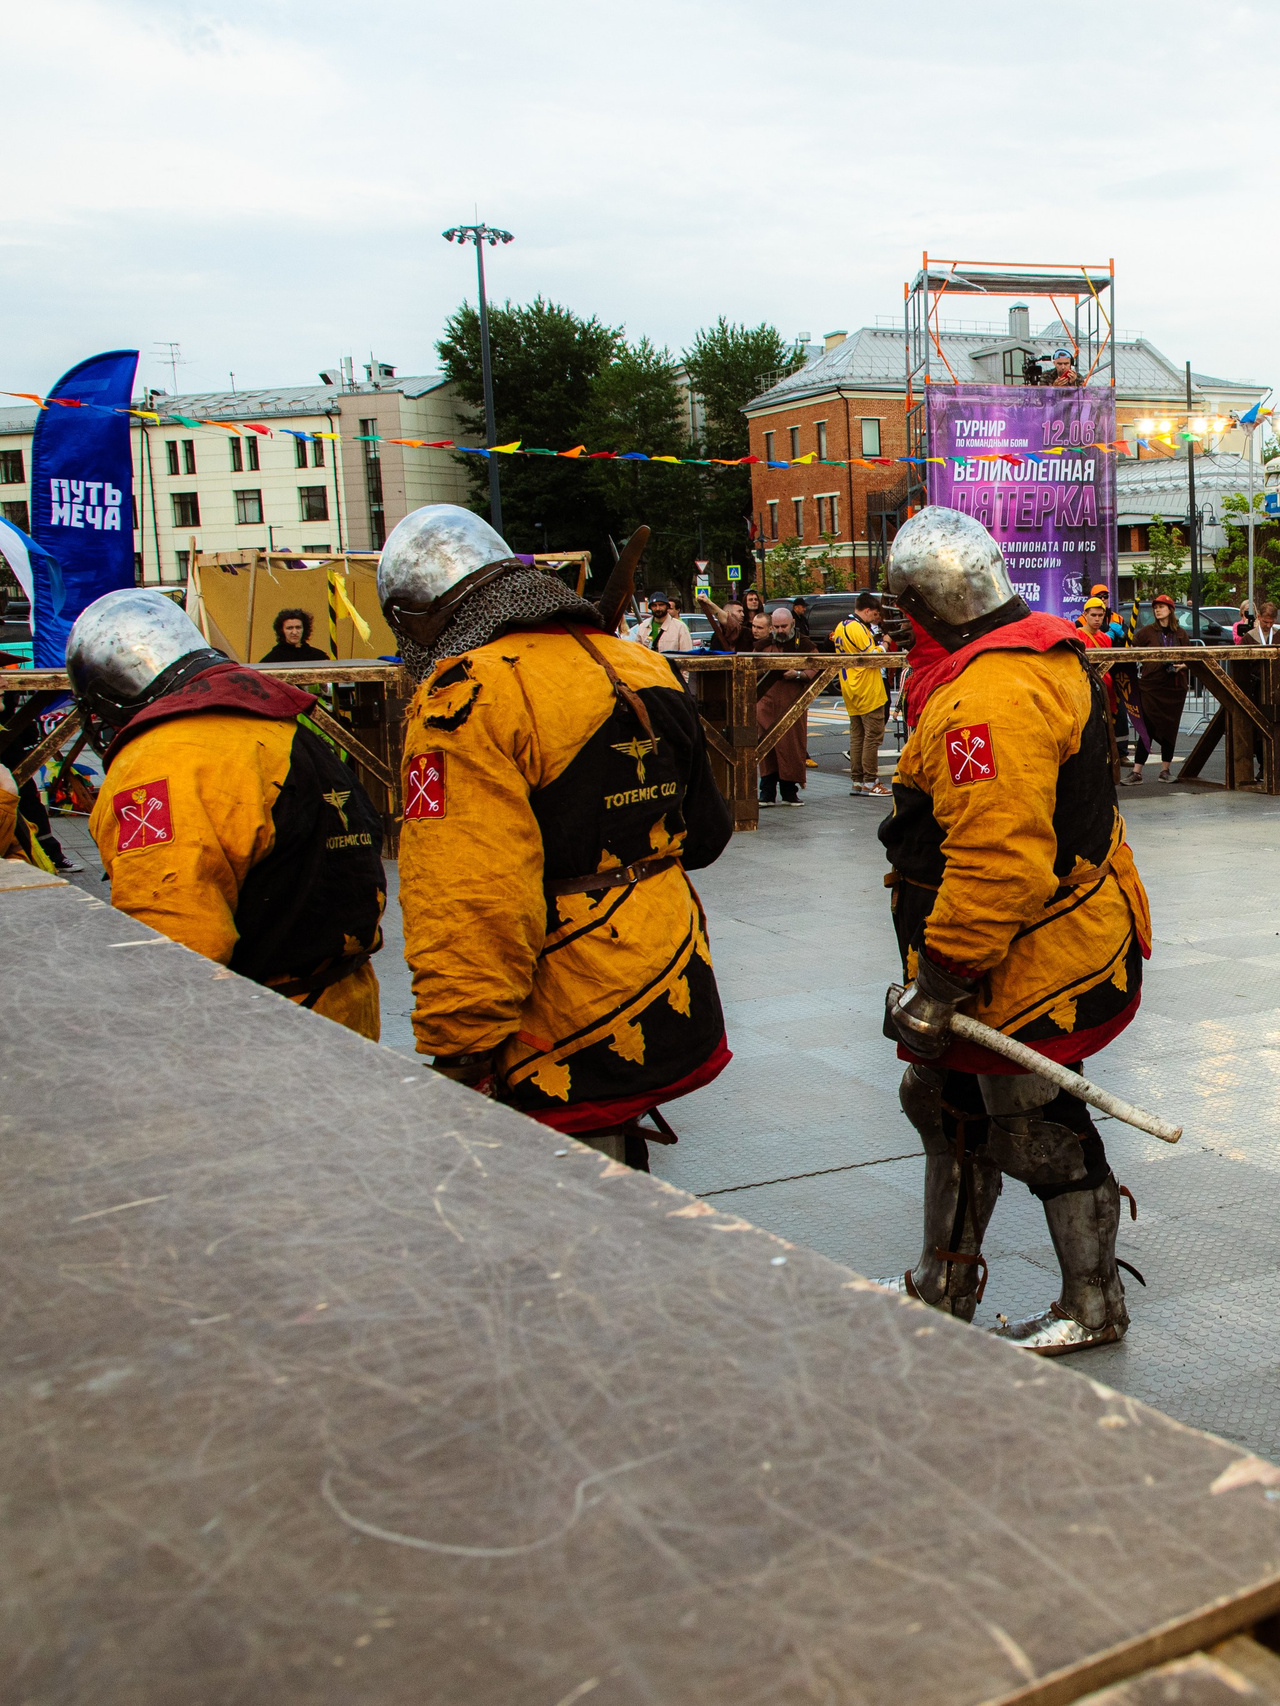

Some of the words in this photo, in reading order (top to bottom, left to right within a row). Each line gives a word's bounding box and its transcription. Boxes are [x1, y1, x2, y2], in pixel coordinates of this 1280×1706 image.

[955, 420, 1006, 437] ТУРНИР
[1042, 420, 1095, 446] 12.06
[956, 438, 965, 447] ПО
[966, 438, 1009, 448] КОМАНДНЫМ
[1010, 438, 1029, 447] БОЯМ
[953, 459, 1096, 482] ВЕЛИКОЛЕПНАЯ
[50, 478, 122, 506] ПУТЬ
[50, 502, 121, 531] МЕЧА
[950, 485, 1098, 528] ПЯТЕРКА
[1062, 541, 1075, 552] ПО
[1078, 541, 1096, 552] ИСБ
[1019, 558, 1061, 569] РОССИИ»
[604, 785, 658, 809] TOTEMIC
